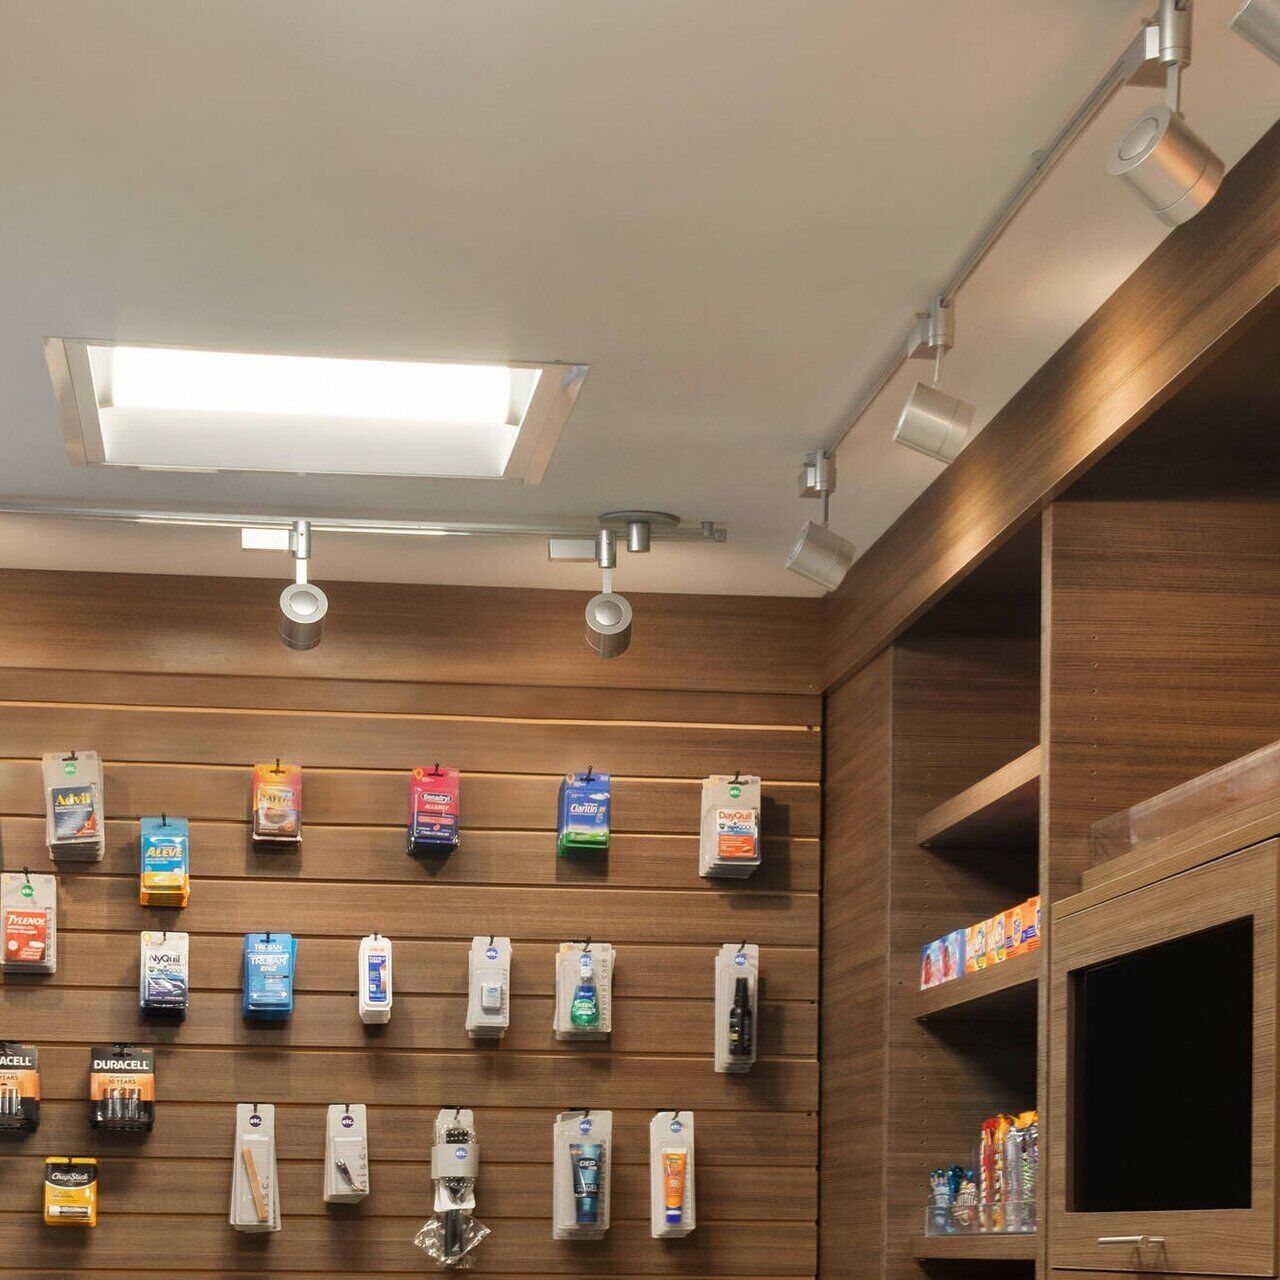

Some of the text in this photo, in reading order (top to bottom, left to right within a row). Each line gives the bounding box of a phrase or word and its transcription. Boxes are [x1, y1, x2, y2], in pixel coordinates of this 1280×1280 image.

[55, 792, 91, 806] Advil
[423, 794, 451, 802] Benadryl
[425, 804, 449, 812] ALLERGY
[570, 804, 597, 814] Claritin
[718, 811, 752, 821] DayQuil
[146, 847, 183, 858] ALEVE
[7, 914, 46, 925] TYLENOL
[149, 954, 181, 965] NyQuil
[250, 957, 287, 966] TROJAN
[93, 1060, 149, 1070] DURACELL
